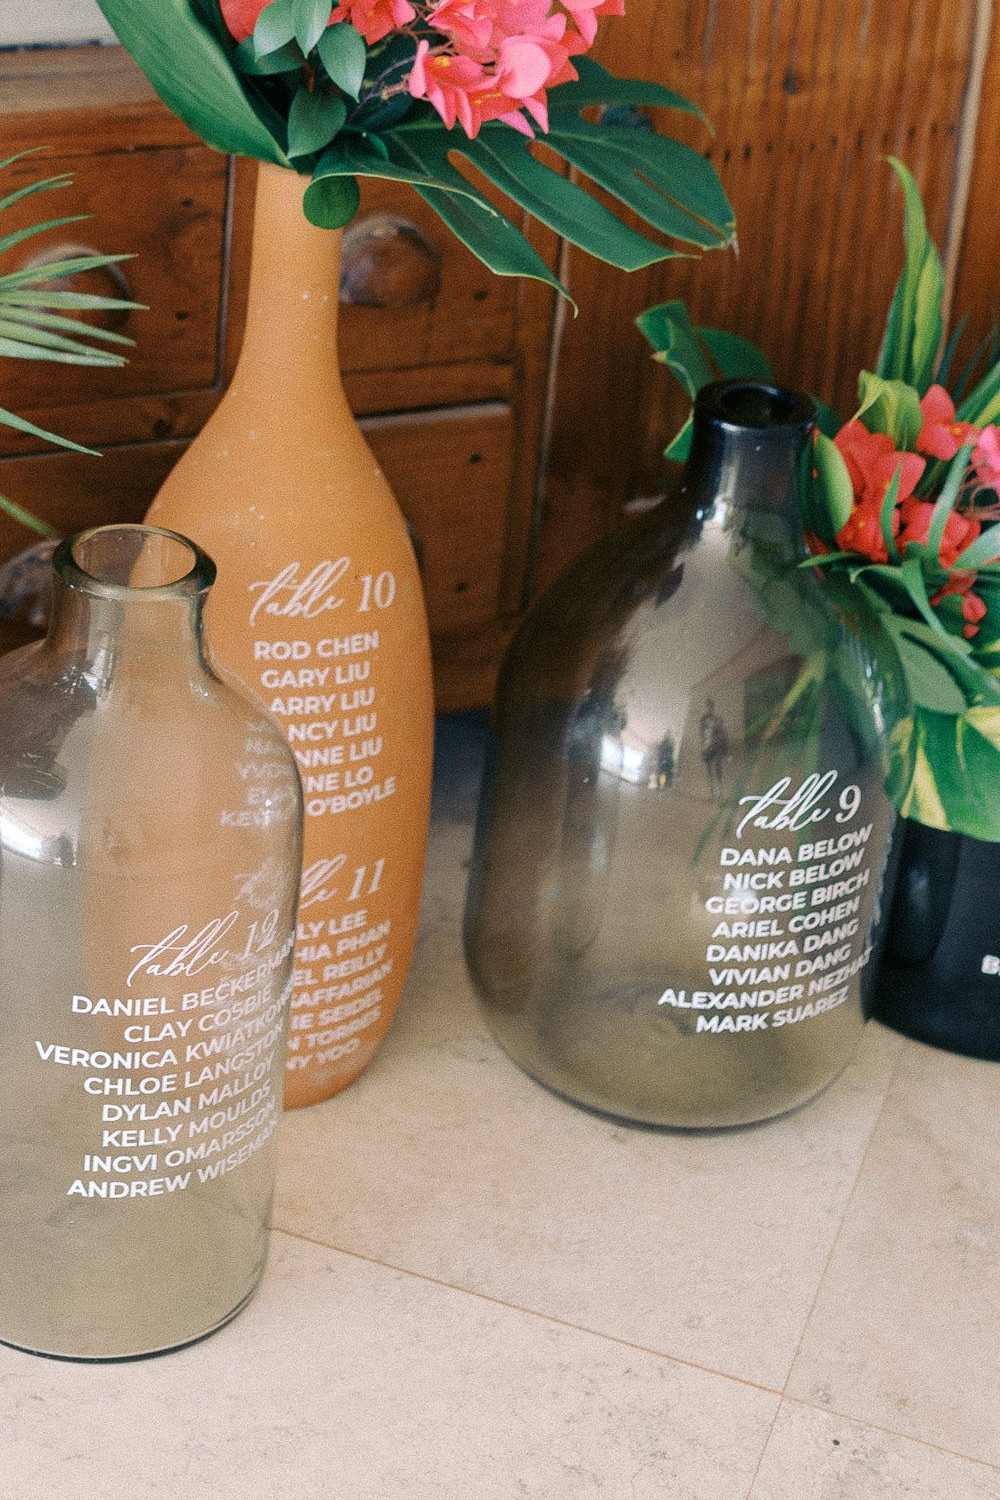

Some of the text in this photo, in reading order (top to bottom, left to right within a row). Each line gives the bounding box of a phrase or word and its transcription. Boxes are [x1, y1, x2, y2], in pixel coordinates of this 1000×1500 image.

[356, 570, 396, 613] 10
[253, 630, 380, 661] ROD CHEN
[260, 660, 371, 689] GARY LIU
[269, 686, 375, 717] ARRY LIU
[343, 712, 378, 738] LIU
[349, 736, 383, 762] LIU
[306, 775, 397, 817] O'BOYLE
[344, 765, 375, 789] LO
[835, 784, 862, 824] 9
[719, 823, 874, 866] DANA BELOW
[346, 858, 385, 902] 11
[722, 848, 866, 891] NICK BELOW
[704, 868, 871, 915] GEORGE BIRCH
[327, 909, 368, 936] LEE
[711, 896, 860, 939] ARIEL COHEN
[705, 918, 859, 963] DANIKA DANG
[708, 943, 851, 987] VIVIAN DANG
[71, 994, 175, 1017] DANIEL
[123, 1019, 193, 1044] CLAY
[197, 983, 272, 1032] COSBIE
[657, 986, 805, 1011] ALEXANDER
[695, 986, 850, 1034] MARK SUAREZ
[34, 1040, 178, 1070] VERONICA
[83, 1073, 177, 1096] CHLOE
[101, 1050, 275, 1123] DYLAN MALLOY
[83, 1094, 276, 1173] INGVI OMARSSON
[101, 1078, 272, 1148] KELLY MOULDS
[66, 1111, 279, 1200] ANDREW WISEMAN
